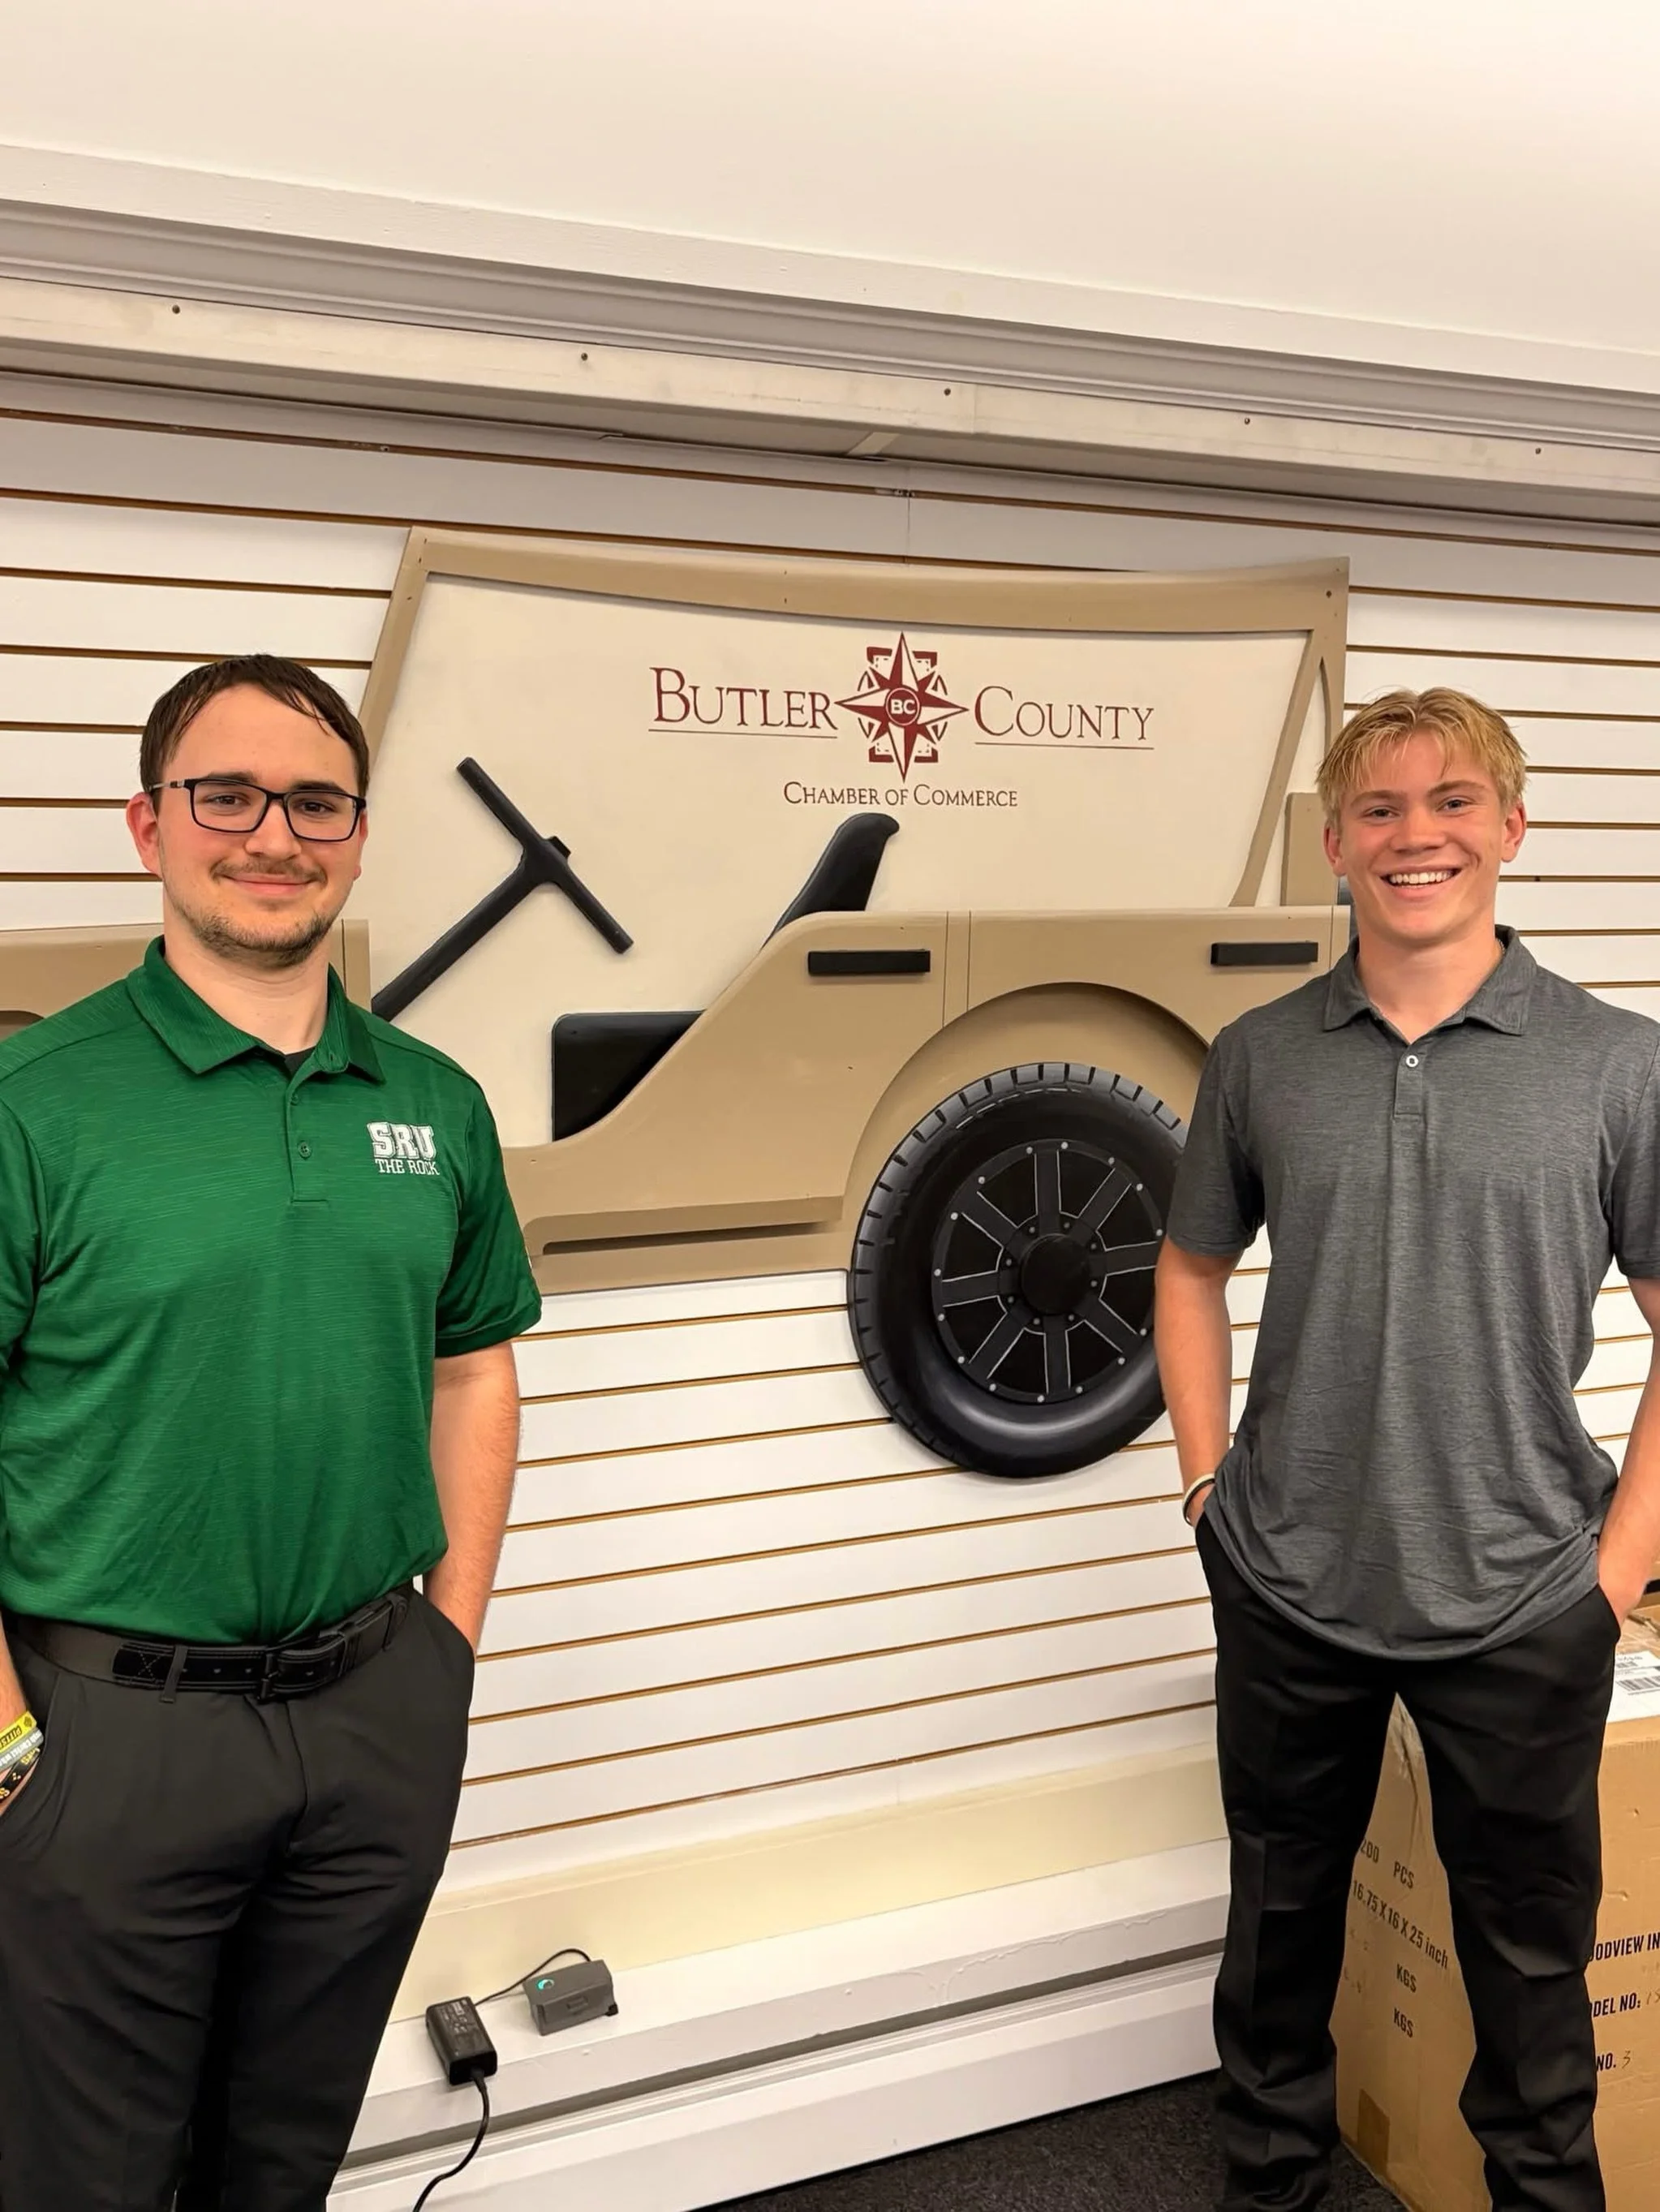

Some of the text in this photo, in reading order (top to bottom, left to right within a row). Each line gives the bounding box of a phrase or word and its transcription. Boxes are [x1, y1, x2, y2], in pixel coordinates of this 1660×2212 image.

[649, 667, 1155, 740] BUTLER COUNTY
[891, 699, 916, 714] BC
[783, 781, 1018, 807] CHAMBER OF COMMERCE
[367, 1121, 437, 1160] SRU
[375, 1159, 440, 1175] THE ROCK
[1393, 1861, 1415, 1890] PCS
[1409, 1926, 1423, 1949] 25
[1425, 1937, 1449, 1970] inch
[1396, 1963, 1417, 1993] KGS
[1590, 1997, 1616, 2018] DEL
[1619, 1992, 1641, 2012] NO:
[1393, 2007, 1414, 2038] KGS
[1597, 2052, 1616, 2072] NO.
